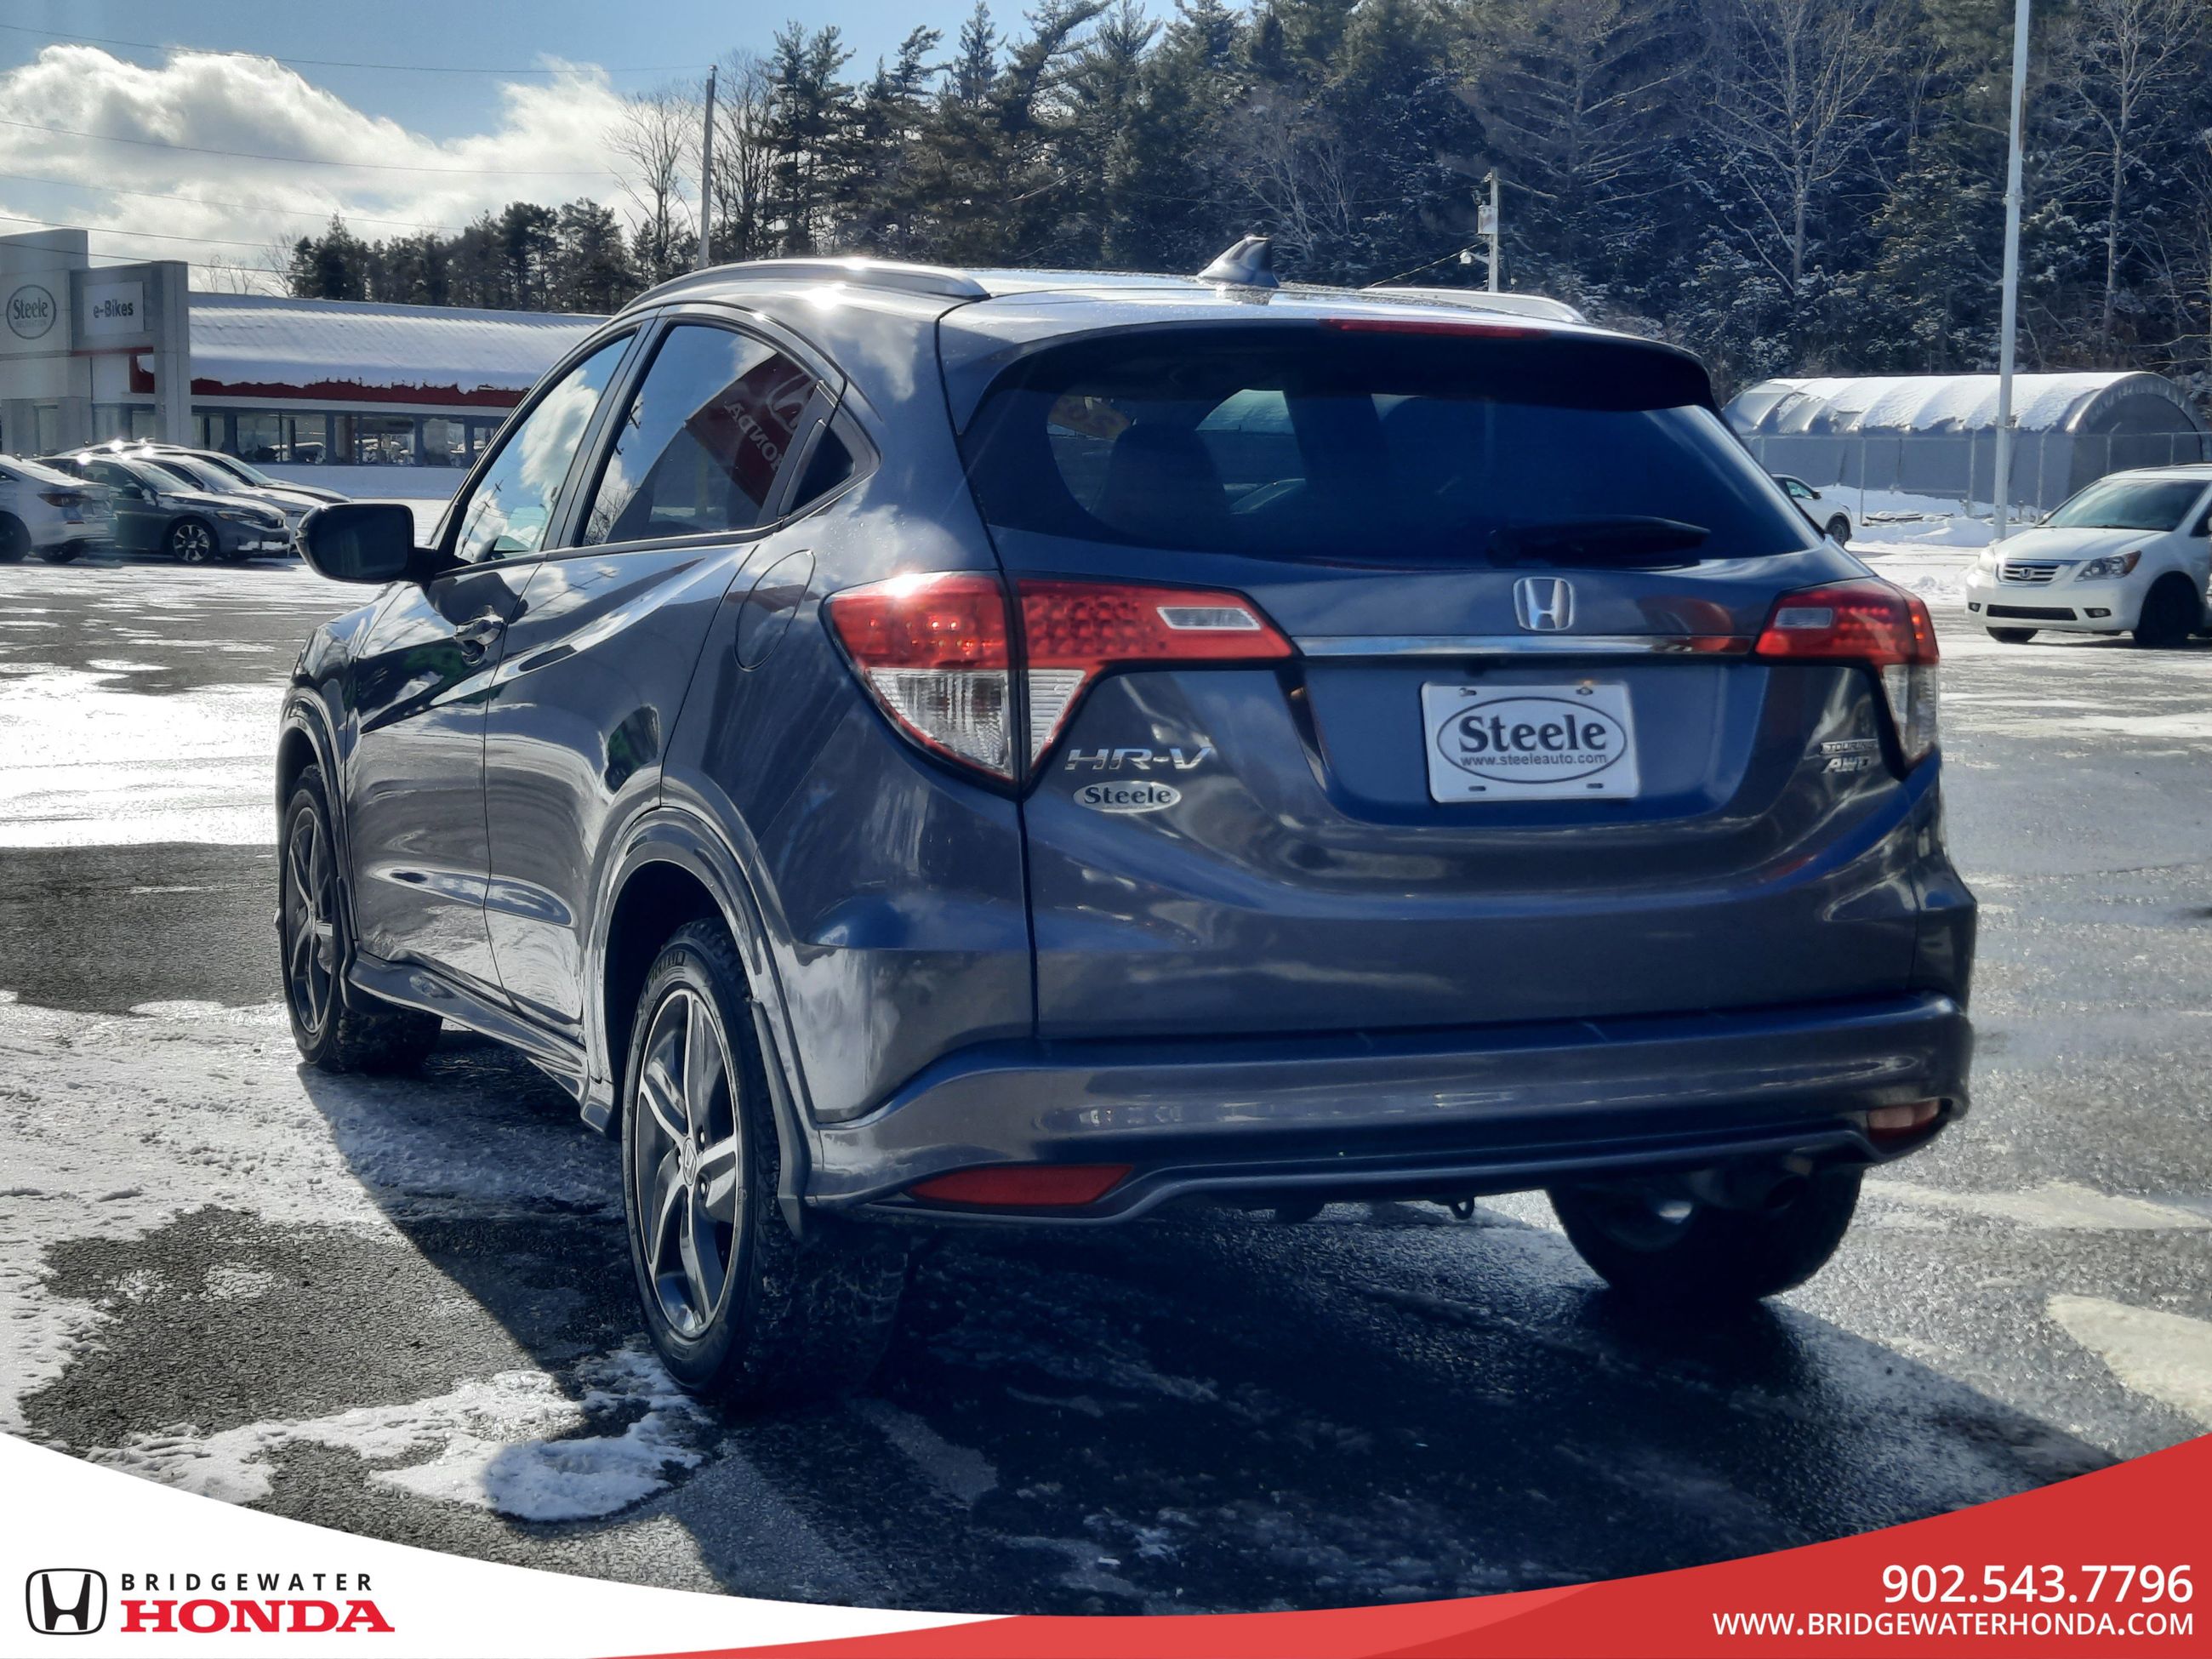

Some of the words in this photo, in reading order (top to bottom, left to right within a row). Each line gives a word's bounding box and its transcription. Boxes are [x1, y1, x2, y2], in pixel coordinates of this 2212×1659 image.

[13, 297, 48, 320] Steele
[93, 299, 134, 319] e-Bikes
[1458, 715, 1607, 752] Steele
[1064, 747, 1213, 771] HR-V
[1459, 753, 1608, 767] www.steeleauto.com
[1082, 787, 1172, 805] Steele
